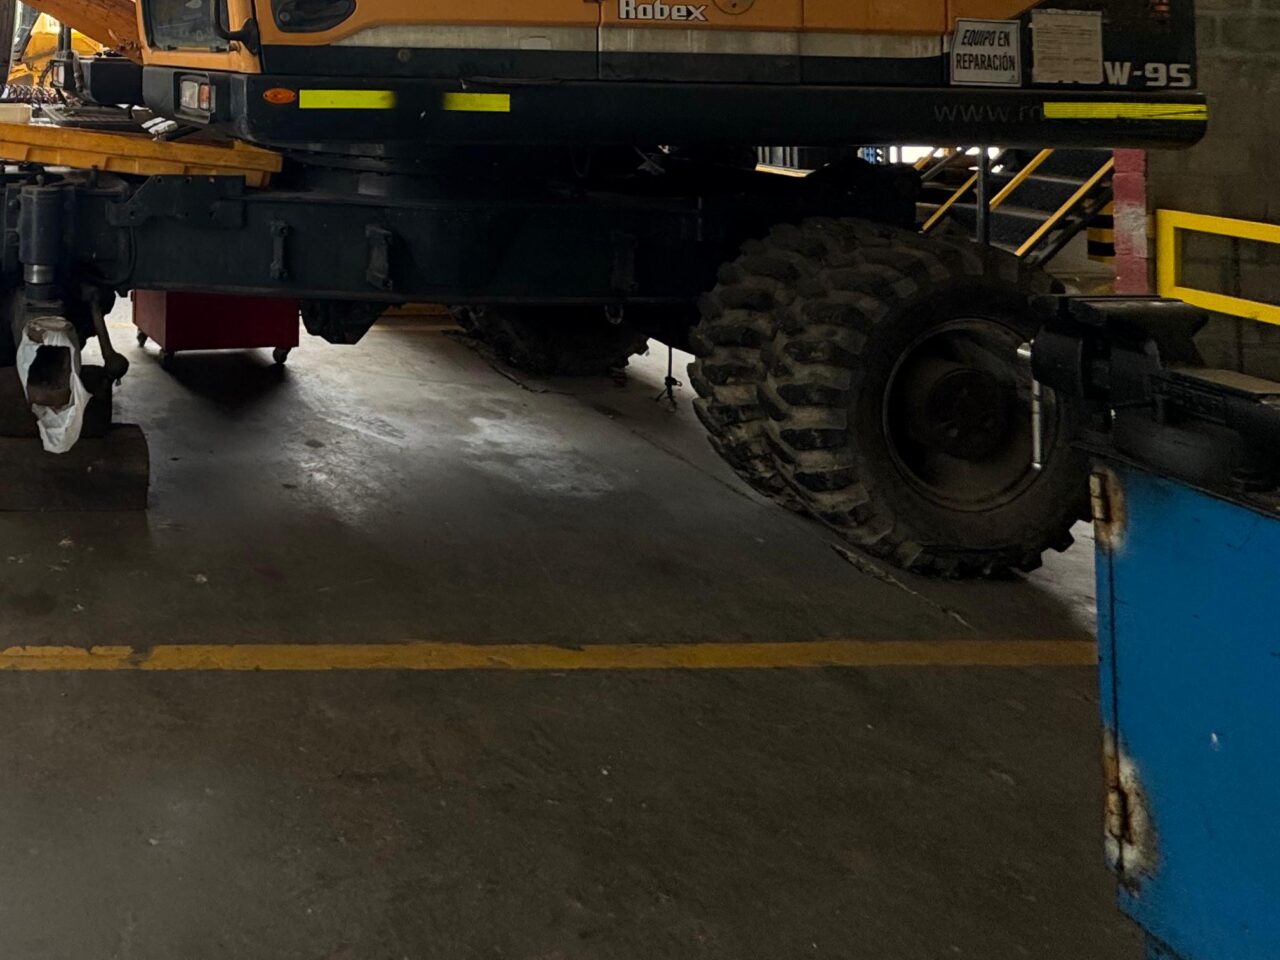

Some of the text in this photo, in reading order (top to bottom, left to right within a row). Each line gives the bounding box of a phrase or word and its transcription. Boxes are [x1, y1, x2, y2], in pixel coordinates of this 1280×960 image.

[961, 29, 1010, 47] EQUIPO EN
[955, 52, 1015, 72] REPARACIÓN
